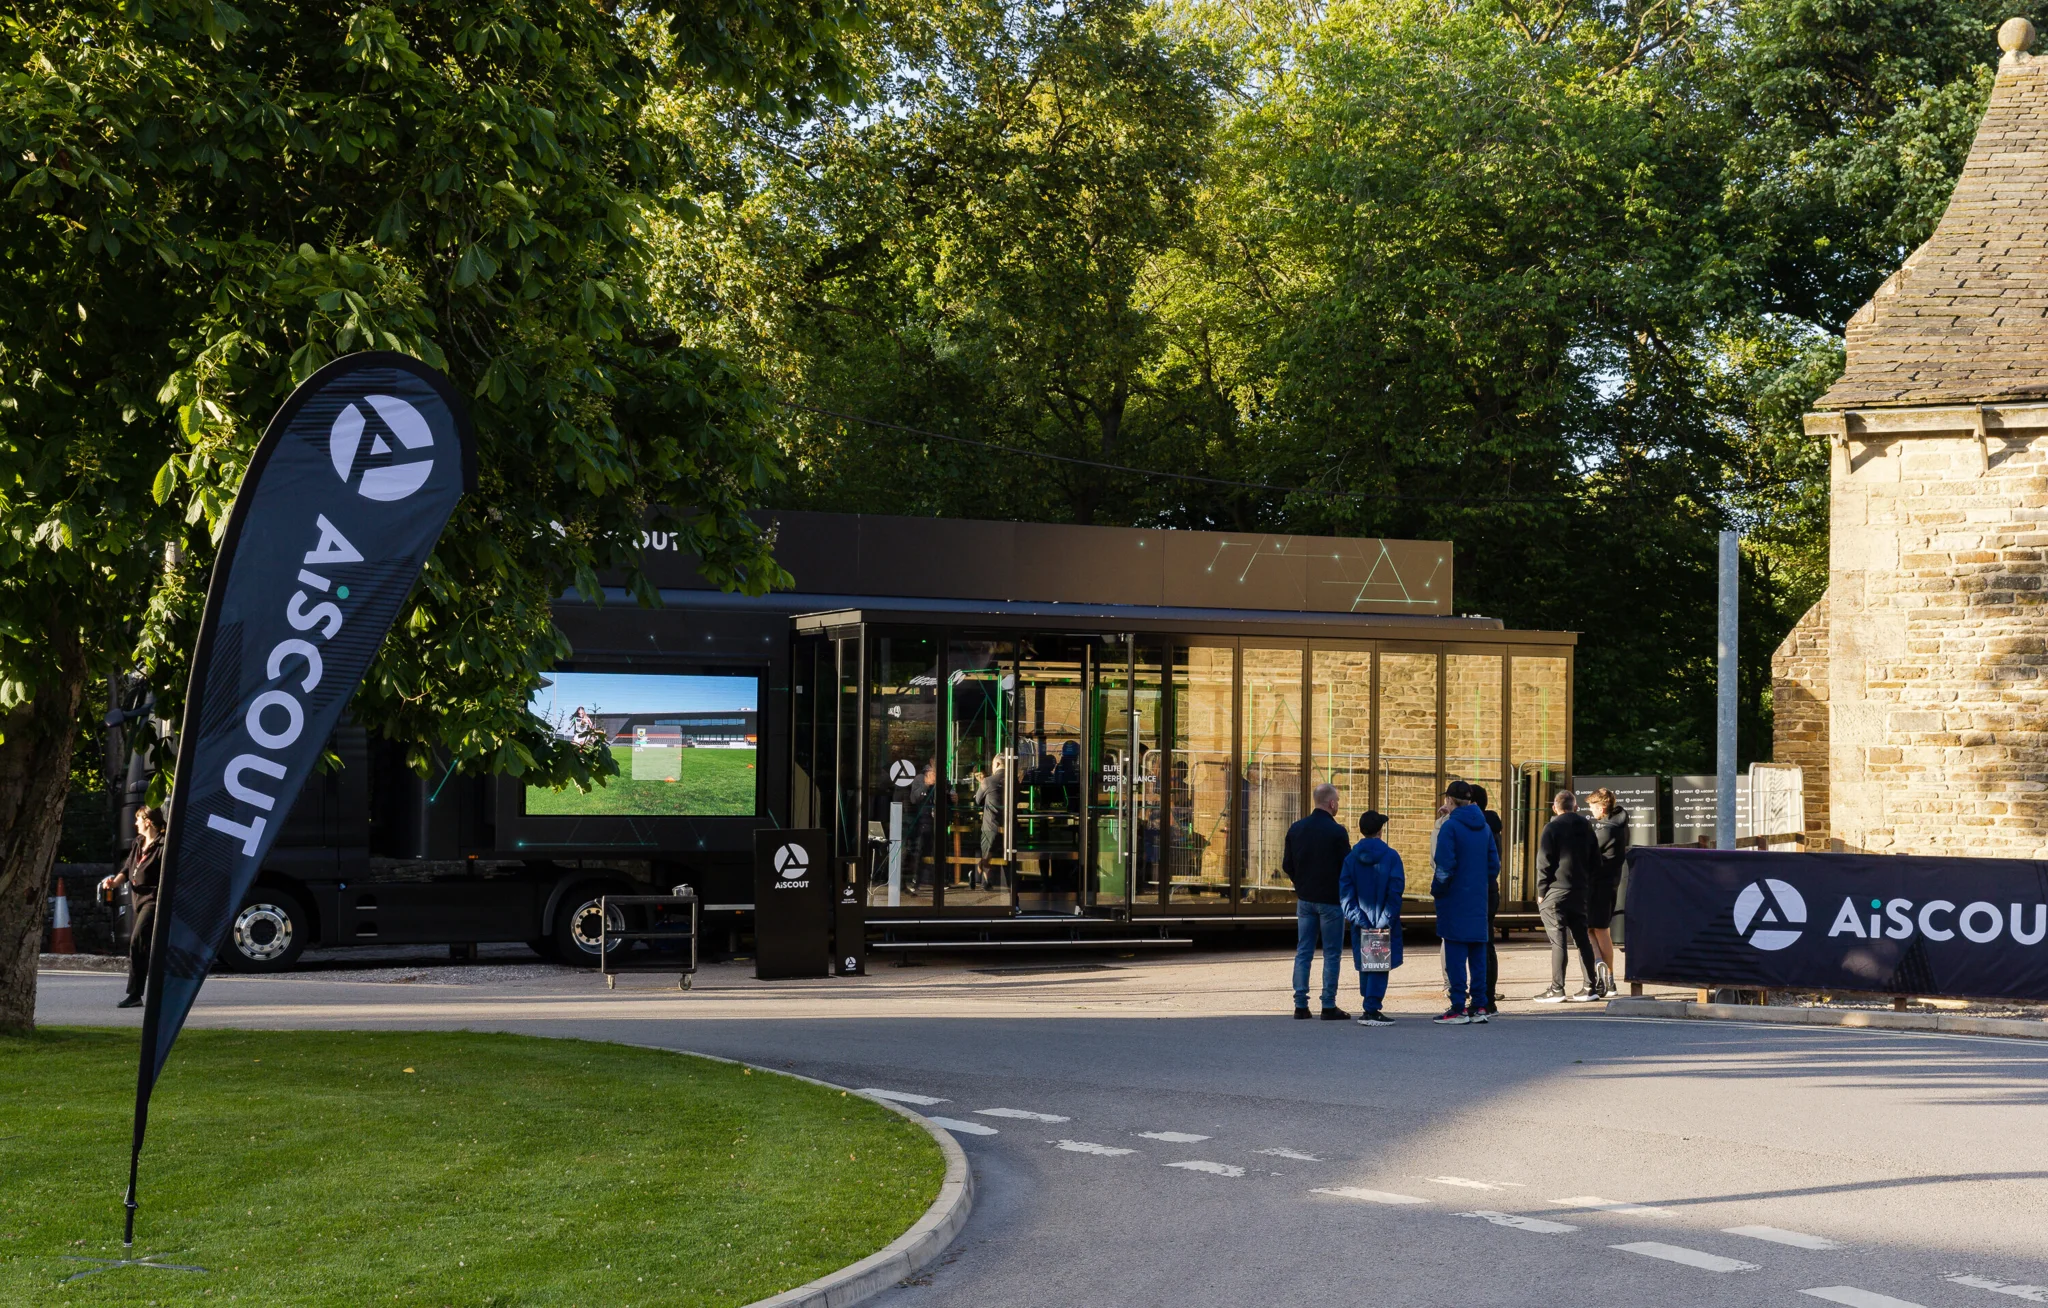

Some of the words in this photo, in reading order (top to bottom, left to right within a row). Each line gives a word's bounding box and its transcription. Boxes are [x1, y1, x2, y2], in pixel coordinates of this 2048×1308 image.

[207, 514, 364, 857] AiSCOUT
[775, 881, 809, 889] AiSCOUT
[1828, 896, 2047, 945] AiSCOU
